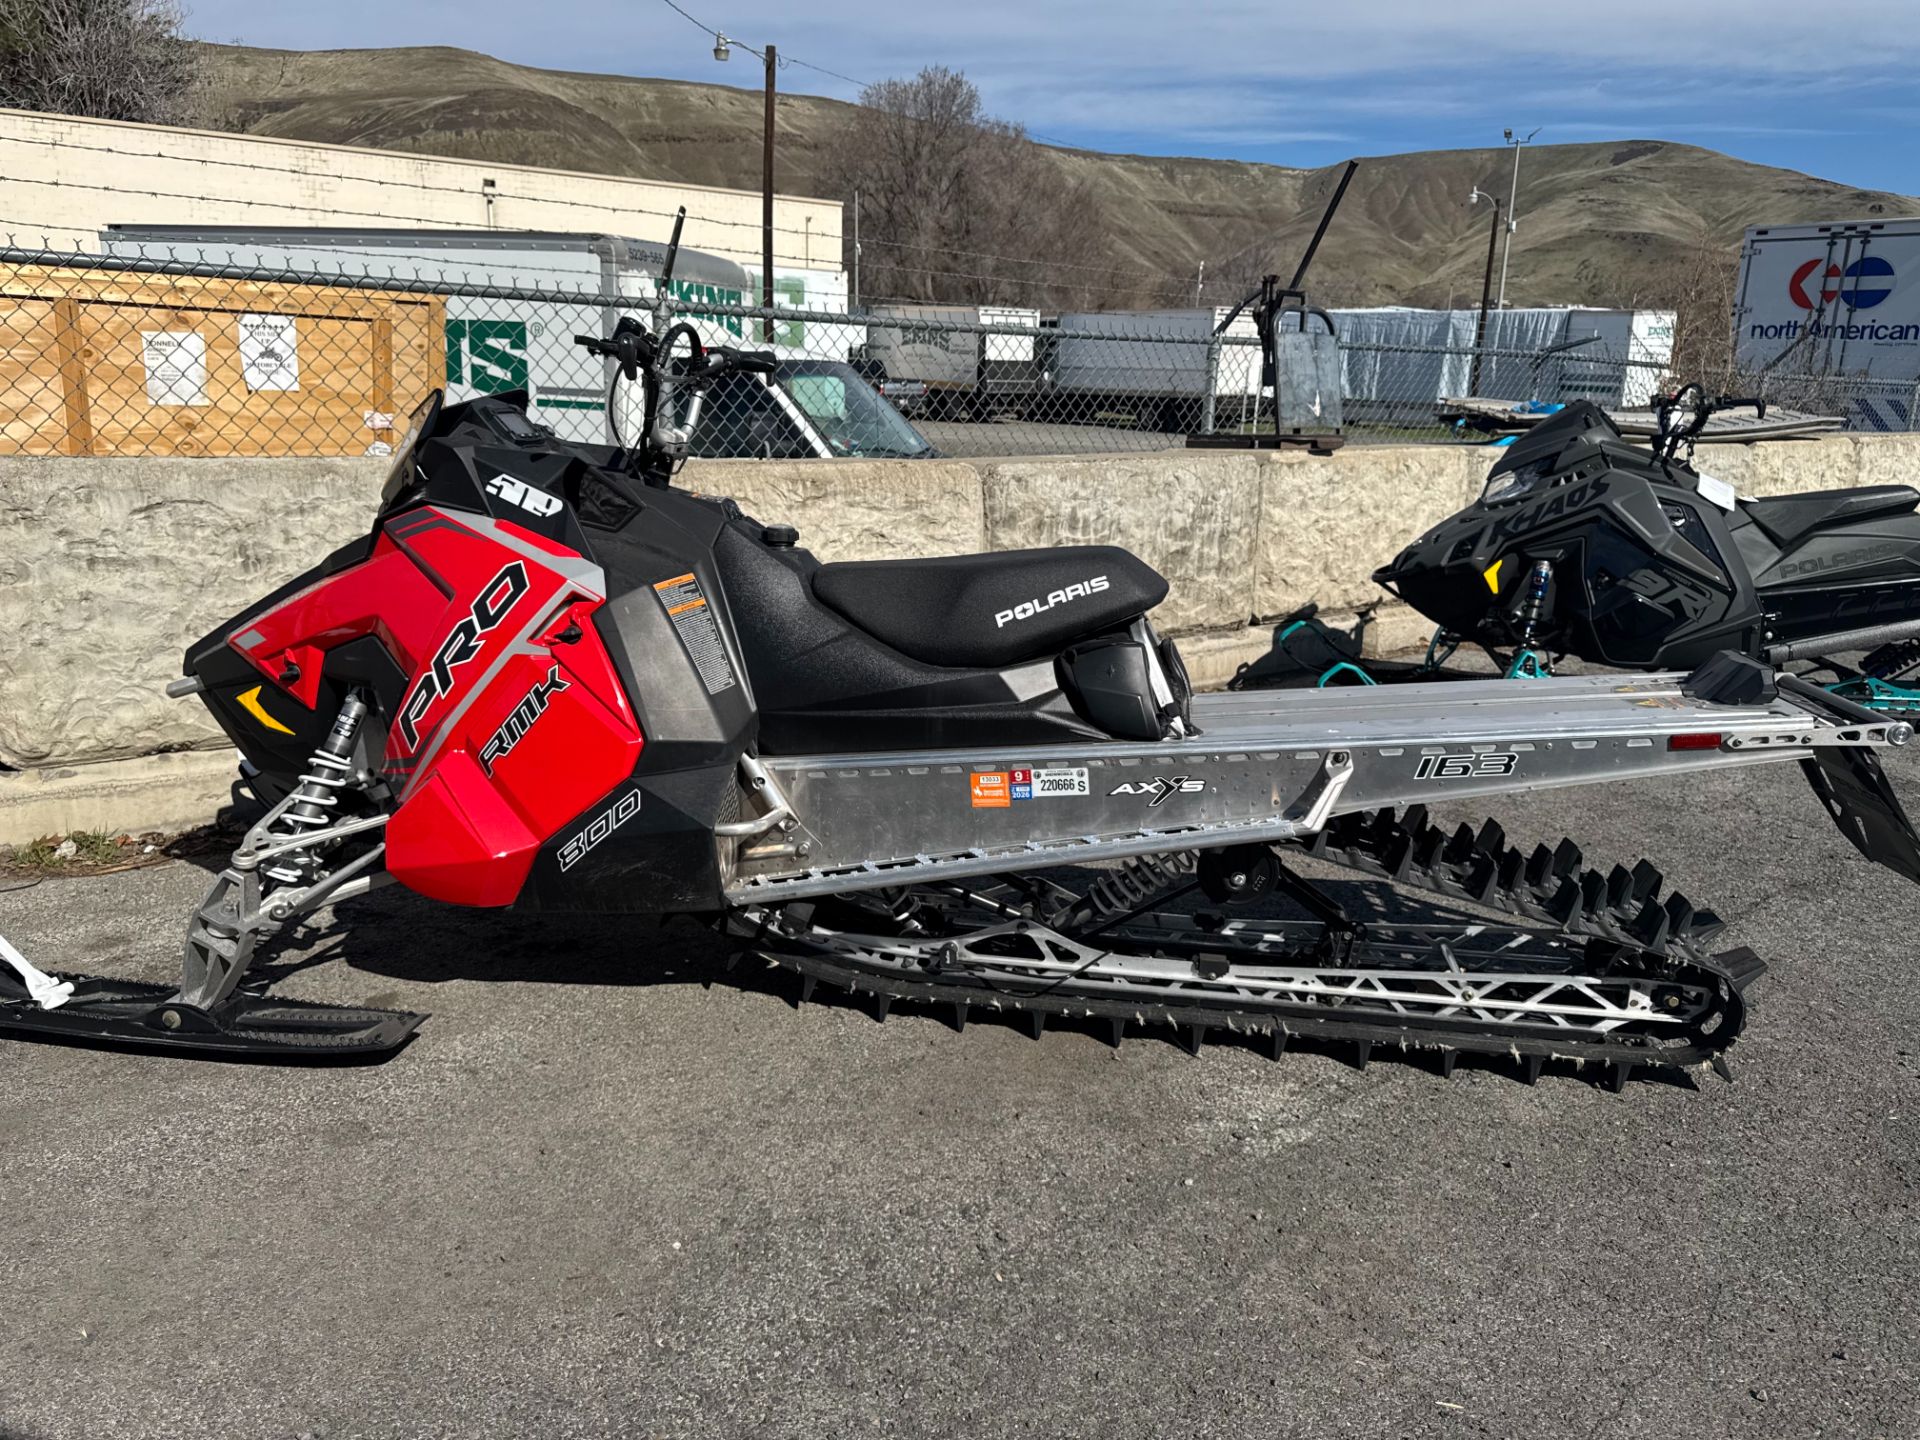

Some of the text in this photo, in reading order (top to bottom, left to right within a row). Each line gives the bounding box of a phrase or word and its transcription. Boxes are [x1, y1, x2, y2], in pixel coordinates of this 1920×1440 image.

[1751, 319, 1920, 341] northAmerican
[995, 575, 1110, 628] POLARIS
[399, 560, 531, 752] PRO
[477, 664, 574, 778] RMK
[1014, 771, 1023, 782] 9
[1413, 752, 1519, 779] 163
[1012, 791, 1031, 799] 2026
[1040, 778, 1087, 792] 220666 S
[1106, 775, 1206, 807] AXYS
[556, 789, 641, 872] 800
